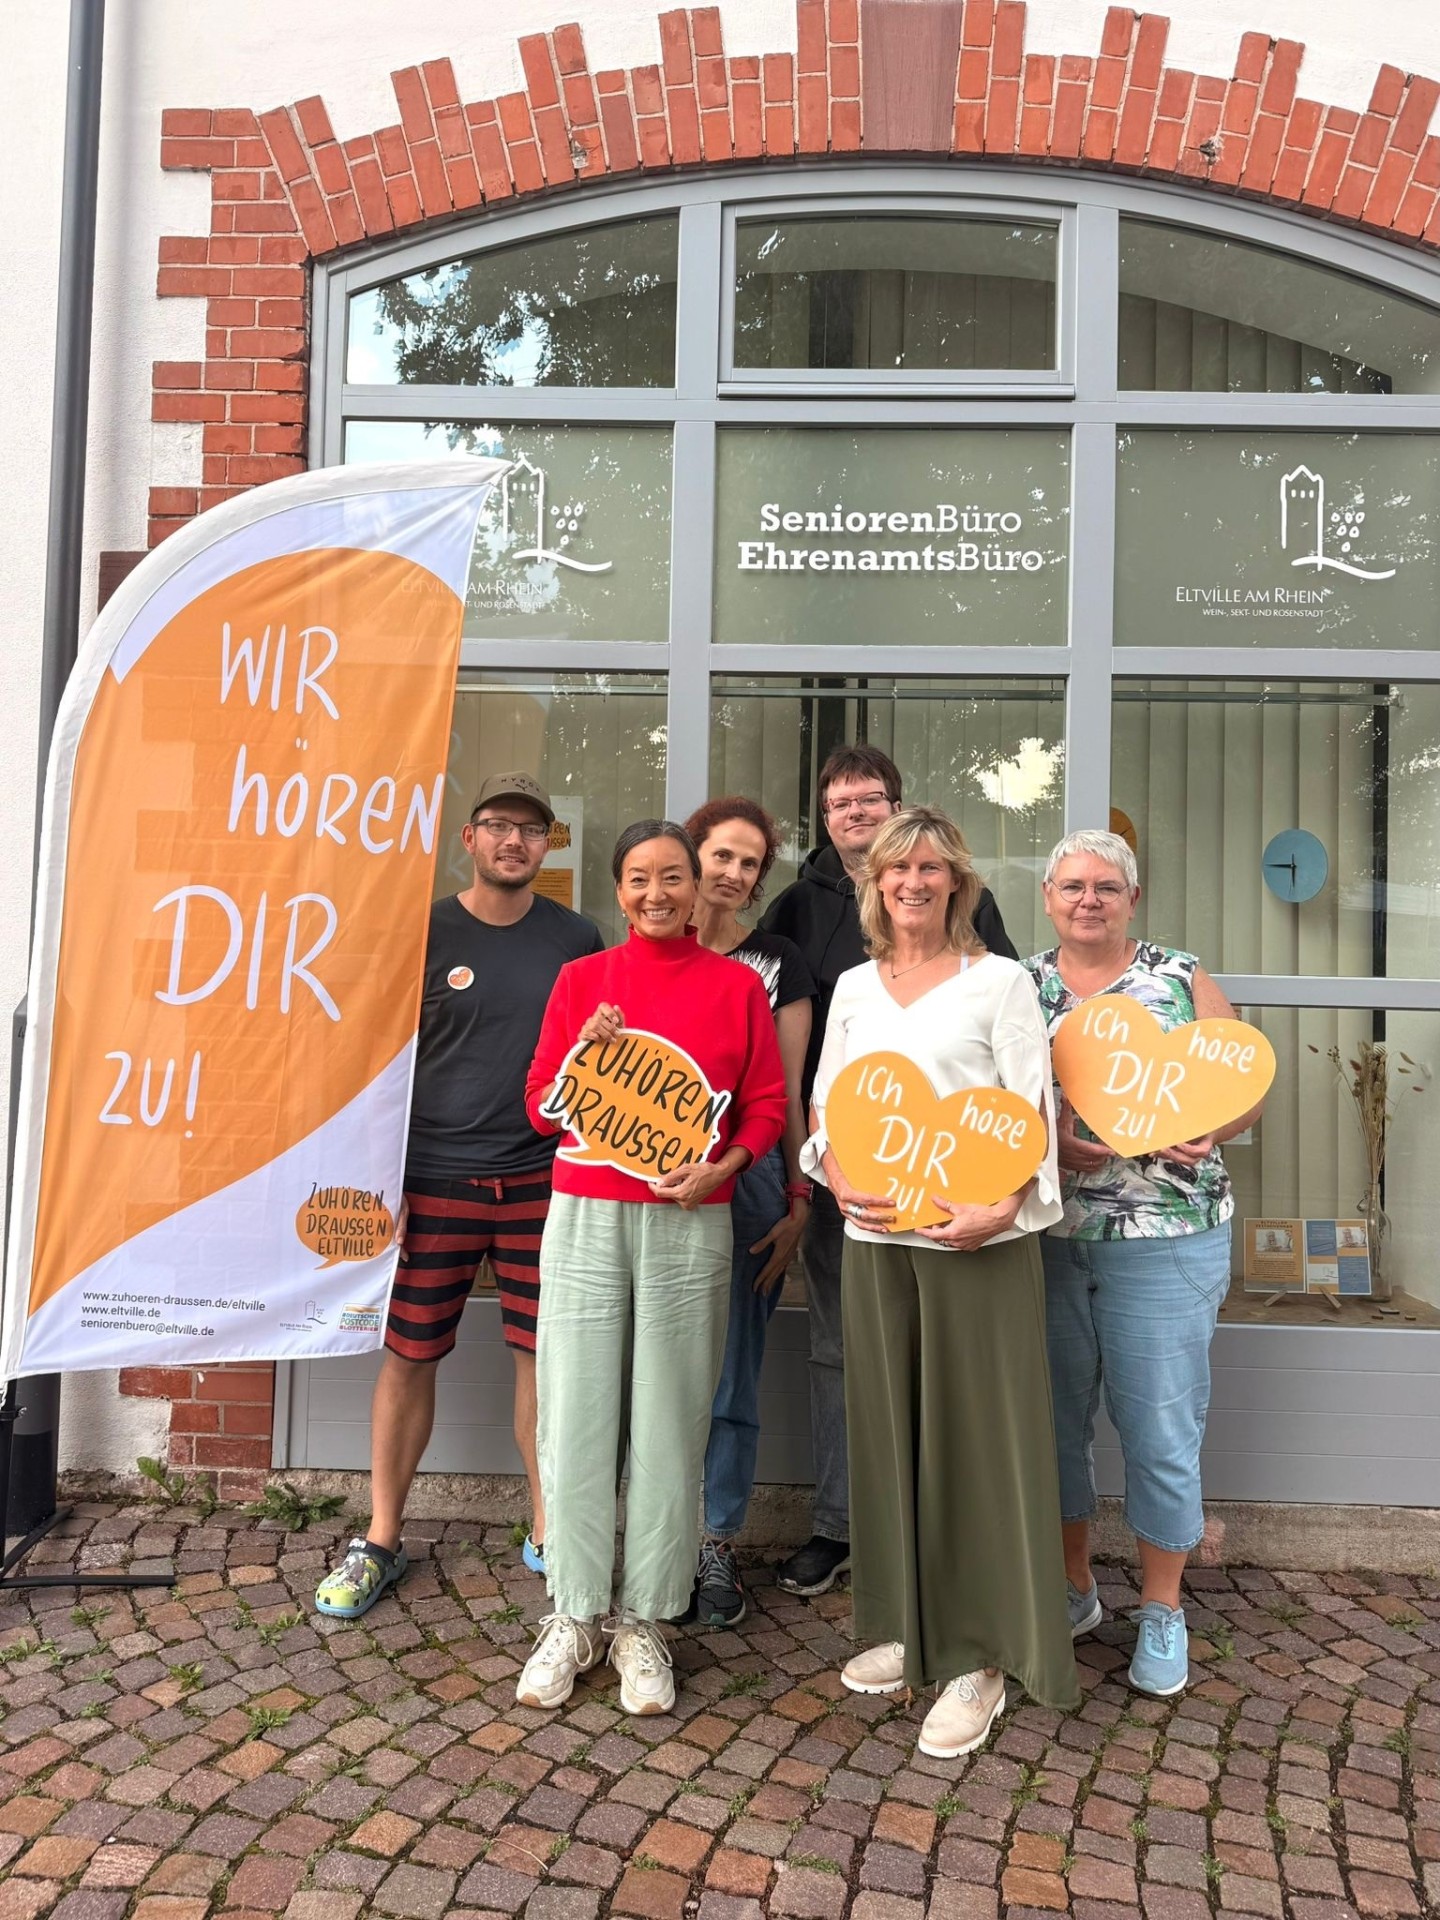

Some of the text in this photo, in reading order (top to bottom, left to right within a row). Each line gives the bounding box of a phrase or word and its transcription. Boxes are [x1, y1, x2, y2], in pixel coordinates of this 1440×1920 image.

[760, 503, 1022, 533] SeniorenBüro
[737, 541, 1043, 571] EhrenamtsBüro
[495, 579, 543, 595] RHEIN
[1176, 586, 1324, 604] ELTVILLE AM RHEIN
[1252, 609, 1272, 617] UND
[1273, 609, 1324, 617] ROSENSTADT
[220, 622, 340, 720] WIR
[152, 885, 341, 1022] DIR
[1102, 1051, 1186, 1113] DIR
[872, 1115, 957, 1188] DIR
[83, 1291, 265, 1311] www.zuhoeren-draussen.de/eltville
[82, 1305, 161, 1318] www.eltville.de
[80, 1318, 215, 1337] seniorenbuero@eltville.de
[340, 1318, 379, 1326] POSTCODE
